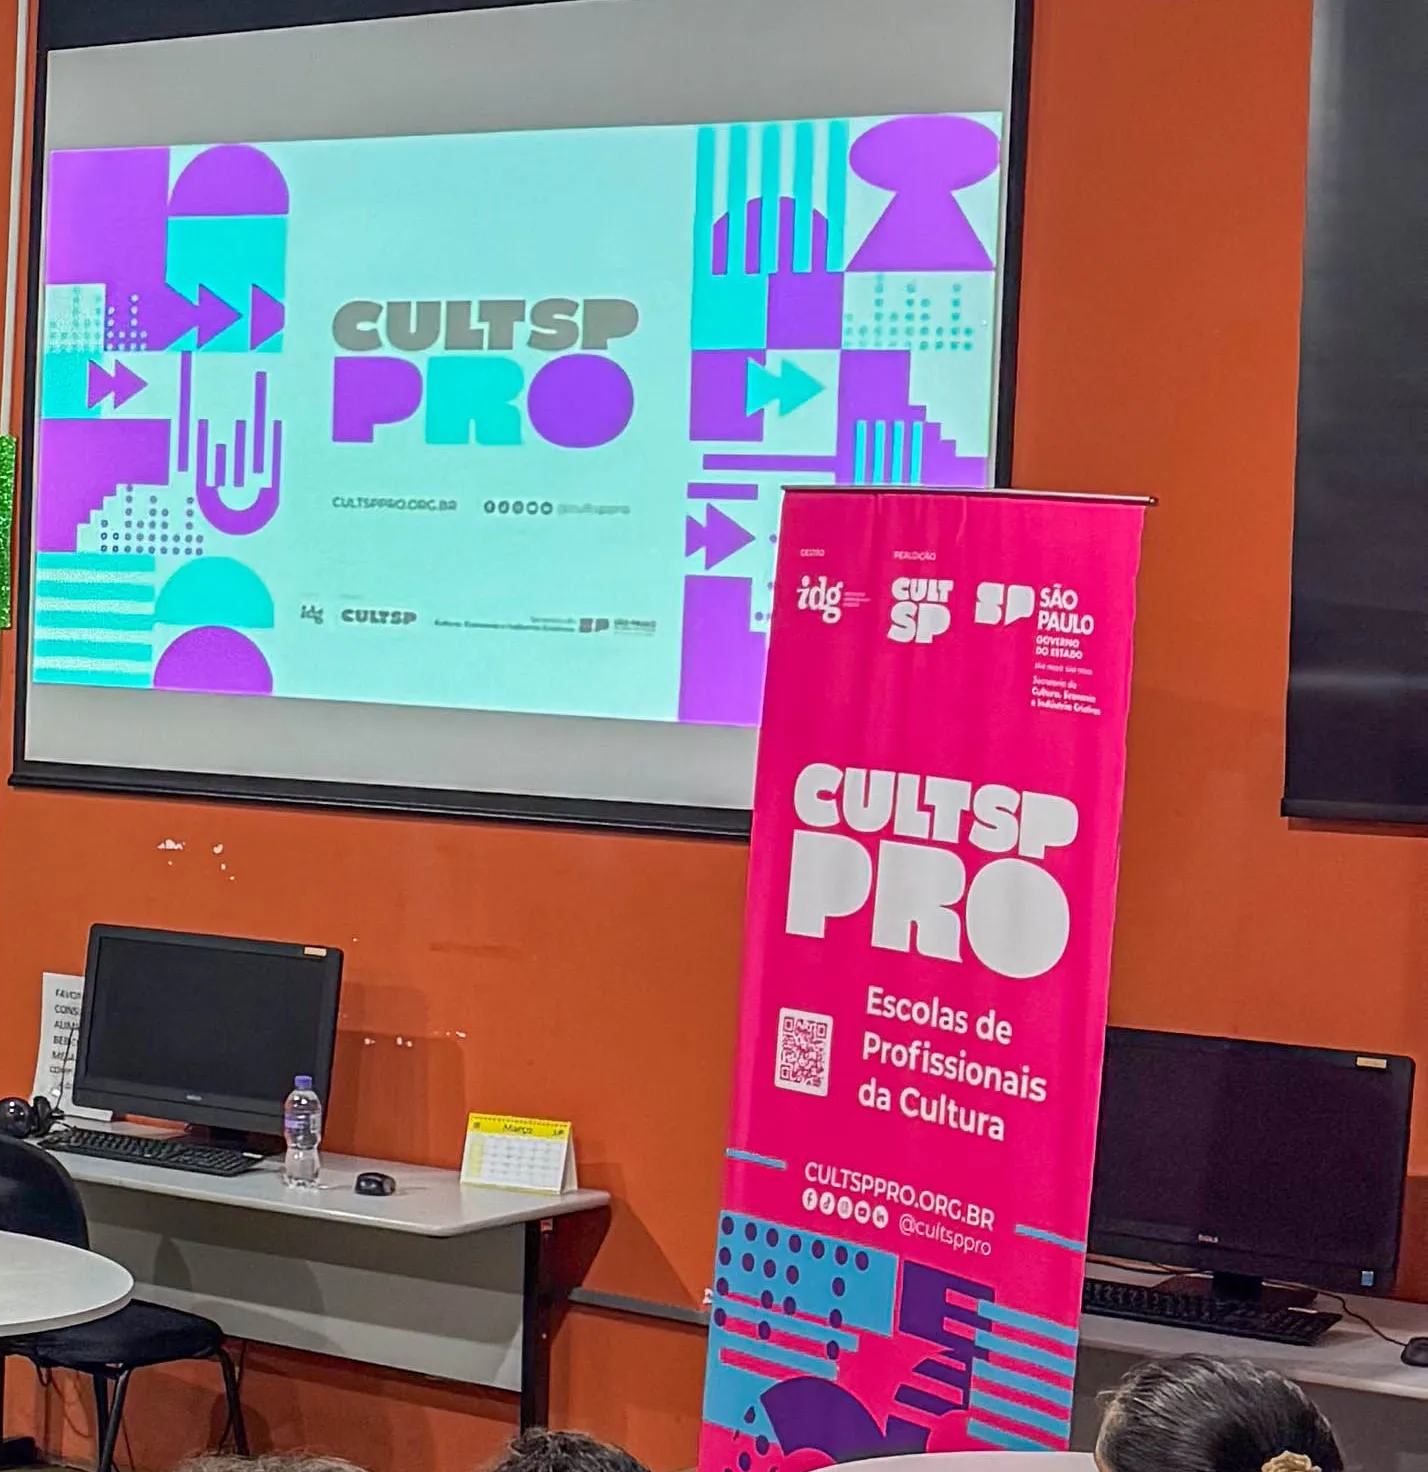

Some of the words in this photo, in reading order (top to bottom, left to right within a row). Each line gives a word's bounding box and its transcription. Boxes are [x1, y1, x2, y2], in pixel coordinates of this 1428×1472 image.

[331, 297, 639, 352] CULTSP
[332, 353, 635, 448] PRO
[796, 575, 844, 624] idg
[891, 577, 954, 603] CULT
[974, 581, 1035, 627] SP
[1039, 583, 1079, 612] SÃO
[340, 608, 417, 626] CULTSP
[887, 600, 951, 644] SP
[1036, 610, 1094, 636] PAULO
[1035, 635, 1080, 649] GOVERNO
[1035, 646, 1050, 657] DO
[1050, 647, 1083, 660] ESTADO
[793, 762, 1079, 860] CULTSP
[785, 828, 1070, 979] PRO
[865, 985, 968, 1036] Escolas
[975, 1013, 1013, 1045] de
[861, 1031, 1048, 1103] Profissionais
[858, 1078, 892, 1112] da
[899, 1087, 1005, 1142] Cultura
[804, 1161, 995, 1232] CULTSPPRO.ORG.BR
[899, 1213, 992, 1257] @cultsppro
